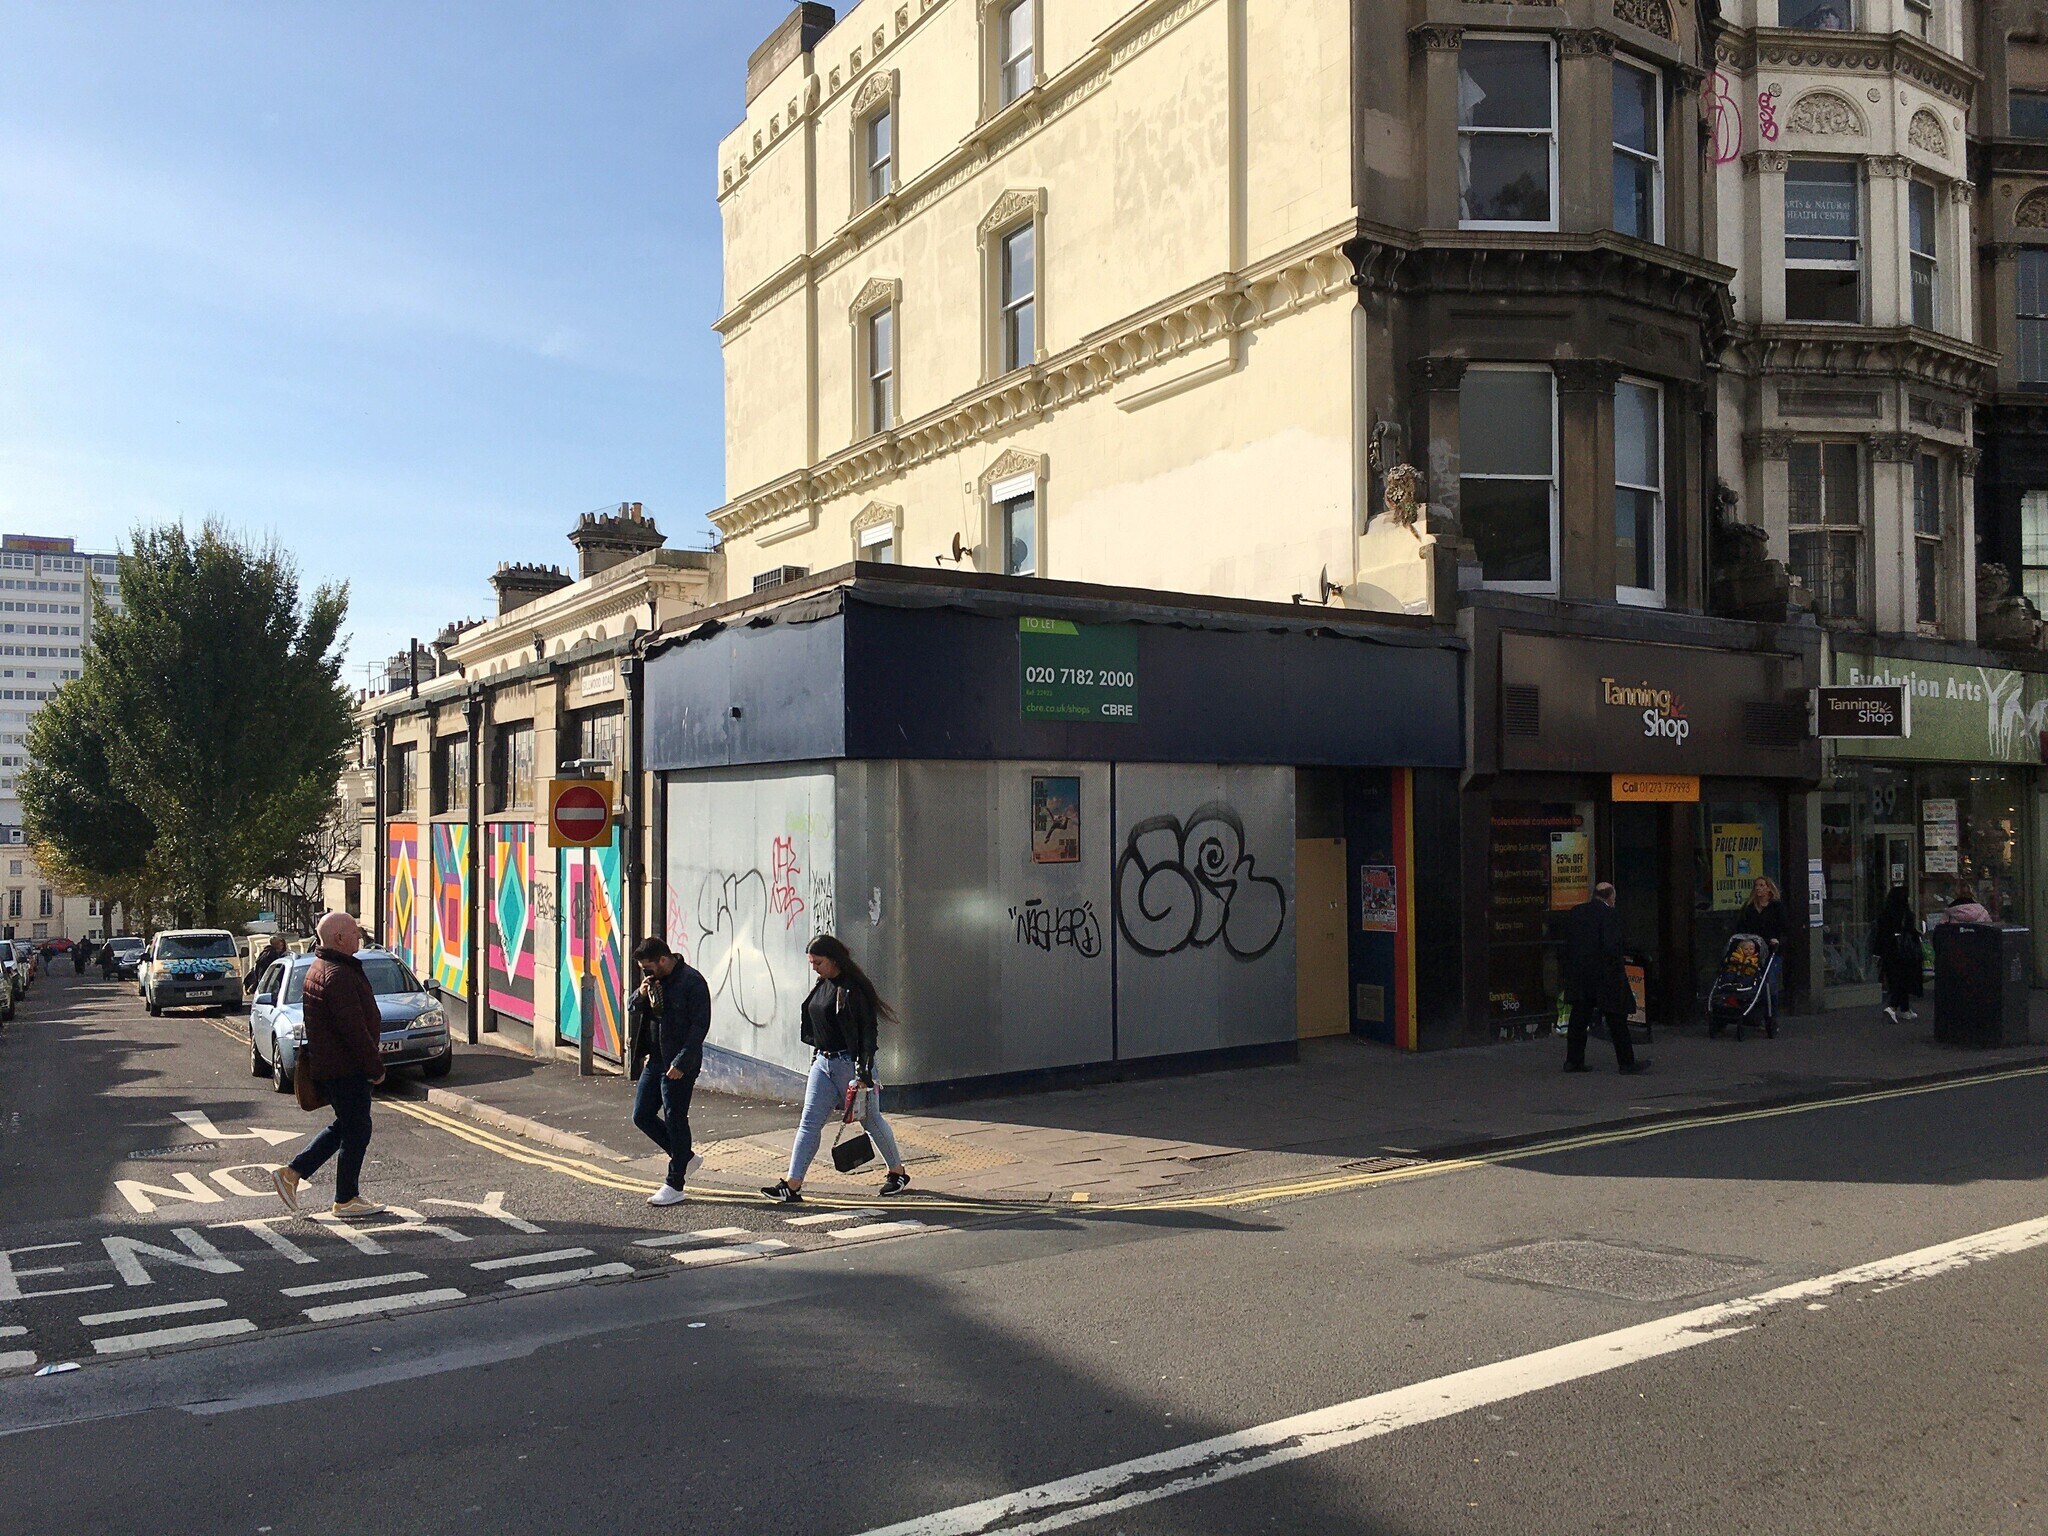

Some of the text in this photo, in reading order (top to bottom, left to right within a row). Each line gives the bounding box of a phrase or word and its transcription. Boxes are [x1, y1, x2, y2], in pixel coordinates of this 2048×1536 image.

[1787, 211, 1850, 220] HEALTH CENTRE
[1026, 617, 1055, 629] TO LET
[1026, 666, 1134, 687] 020 7182 2000
[1946, 677, 1981, 702] Arts
[1601, 678, 1671, 717] Tanning
[1026, 703, 1090, 715] cbre.co.uk/shops
[1101, 703, 1133, 715] CBRE
[1827, 698, 1880, 713] Tanning
[1858, 710, 1894, 726] Shop
[1643, 708, 1690, 745] Shop
[1622, 782, 1691, 794] Call 01273 779993
[1872, 783, 1897, 816] 89
[1715, 837, 1762, 852] PRICE DROP!
[1556, 854, 1584, 864] 25% OFF
[114, 1162, 312, 1214] NO
[0, 1190, 547, 1302] ENTRY
